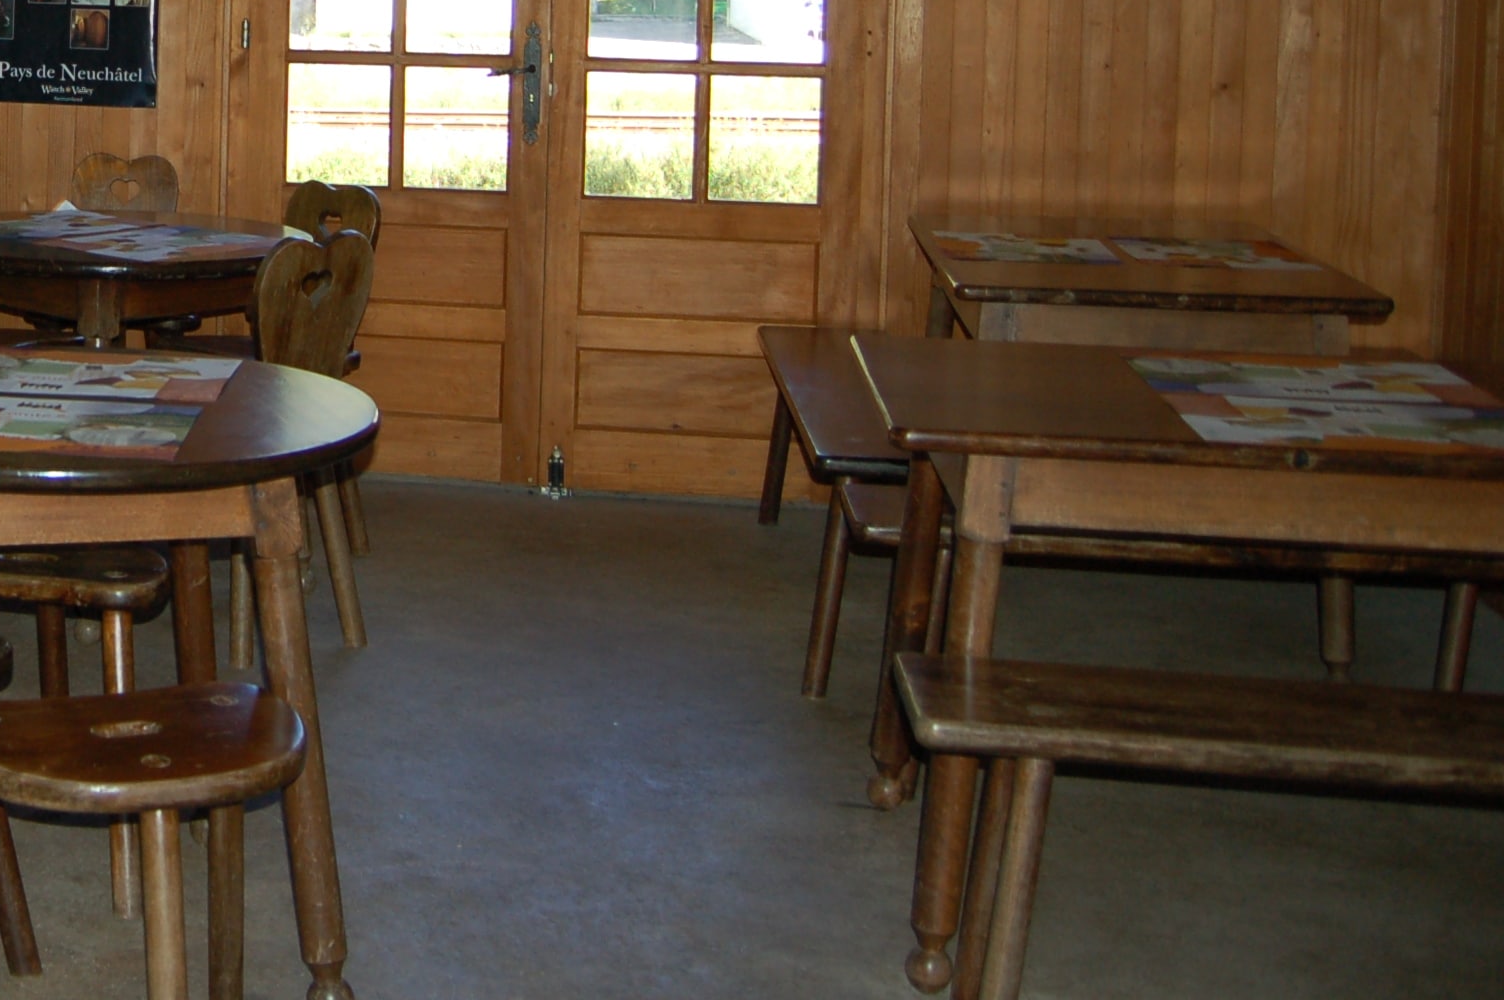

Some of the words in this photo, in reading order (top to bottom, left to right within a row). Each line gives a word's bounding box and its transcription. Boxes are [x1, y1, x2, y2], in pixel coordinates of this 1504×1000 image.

[37, 64, 55, 79] de
[60, 63, 142, 82] Neuchâtel
[41, 84, 65, 95] Watch
